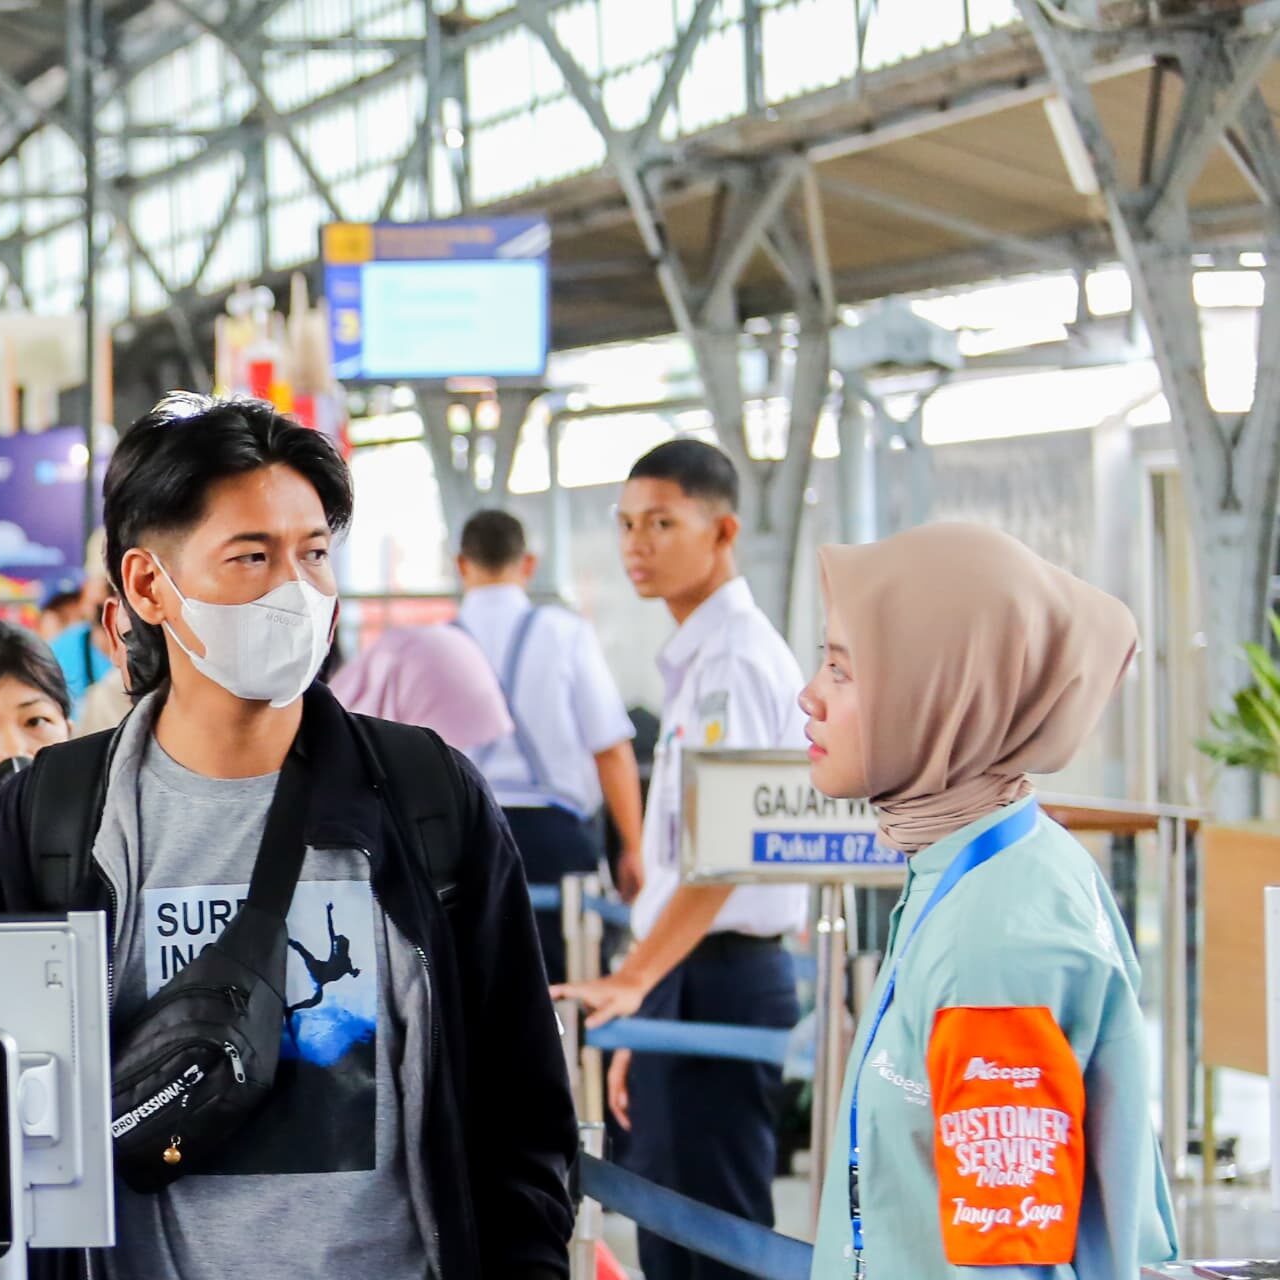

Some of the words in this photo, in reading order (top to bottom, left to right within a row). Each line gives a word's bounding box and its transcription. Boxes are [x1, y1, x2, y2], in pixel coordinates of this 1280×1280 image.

[765, 834, 827, 861] Pukul
[157, 898, 249, 938] SUR
[160, 943, 216, 980] IN
[963, 1056, 1042, 1081] Access
[941, 1106, 1069, 1147] CUSTOMER
[956, 1138, 1056, 1176] SERVICE
[951, 1197, 1011, 1232] Tanya
[1016, 1196, 1063, 1230] Saya
